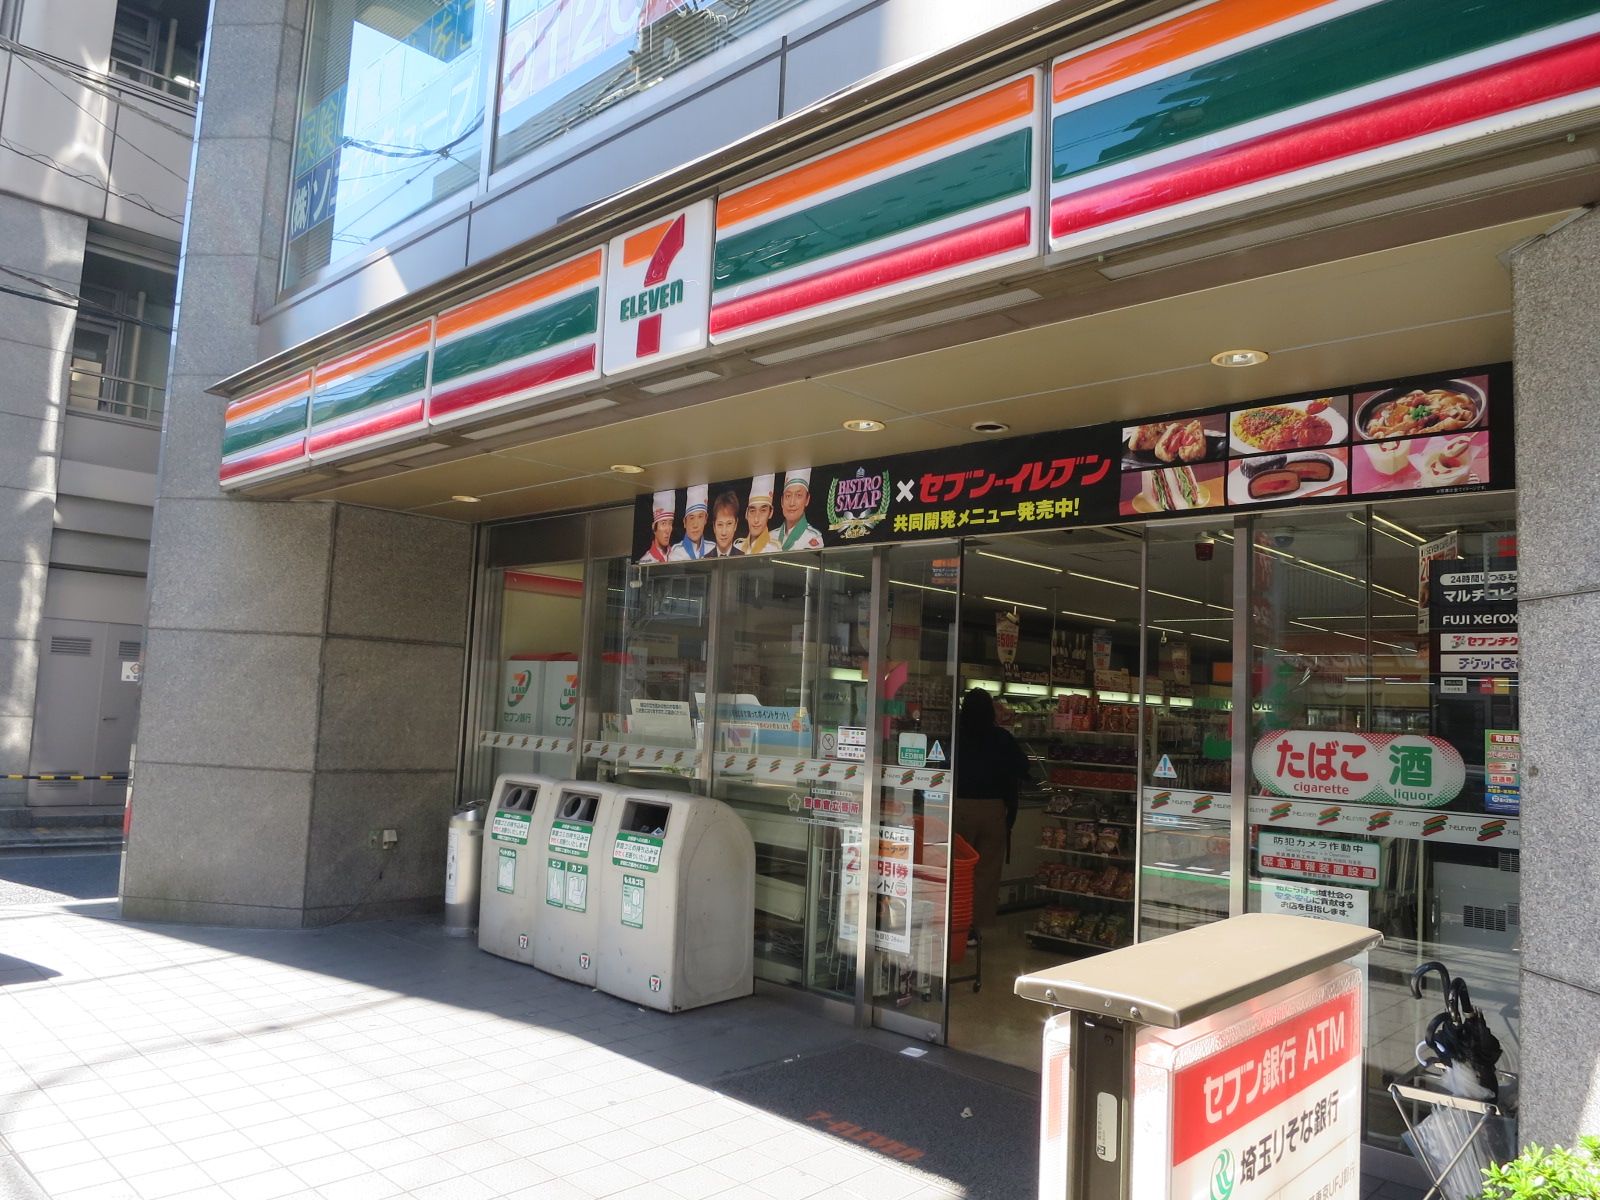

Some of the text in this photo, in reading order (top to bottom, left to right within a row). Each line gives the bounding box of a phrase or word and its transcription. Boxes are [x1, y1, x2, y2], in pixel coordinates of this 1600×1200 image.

[623, 213, 685, 359] 7
[620, 278, 684, 322] ELEVEN
[838, 475, 882, 496] BISTRO
[835, 490, 882, 513] SMAP
[893, 497, 1080, 532] 共同開発メニュー発売中!
[1442, 613, 1519, 625] FUJI xerox
[1458, 657, 1519, 670] チケットぴ
[1276, 738, 1434, 788] たばこ 酒
[1293, 781, 1350, 796] cigarette
[1393, 788, 1434, 804] liquor
[1272, 836, 1365, 853] 防犯カメラ作動中
[1203, 1011, 1345, 1125] セブン銀行 ATM
[1239, 1089, 1340, 1186] 埼玉りそな銀行
